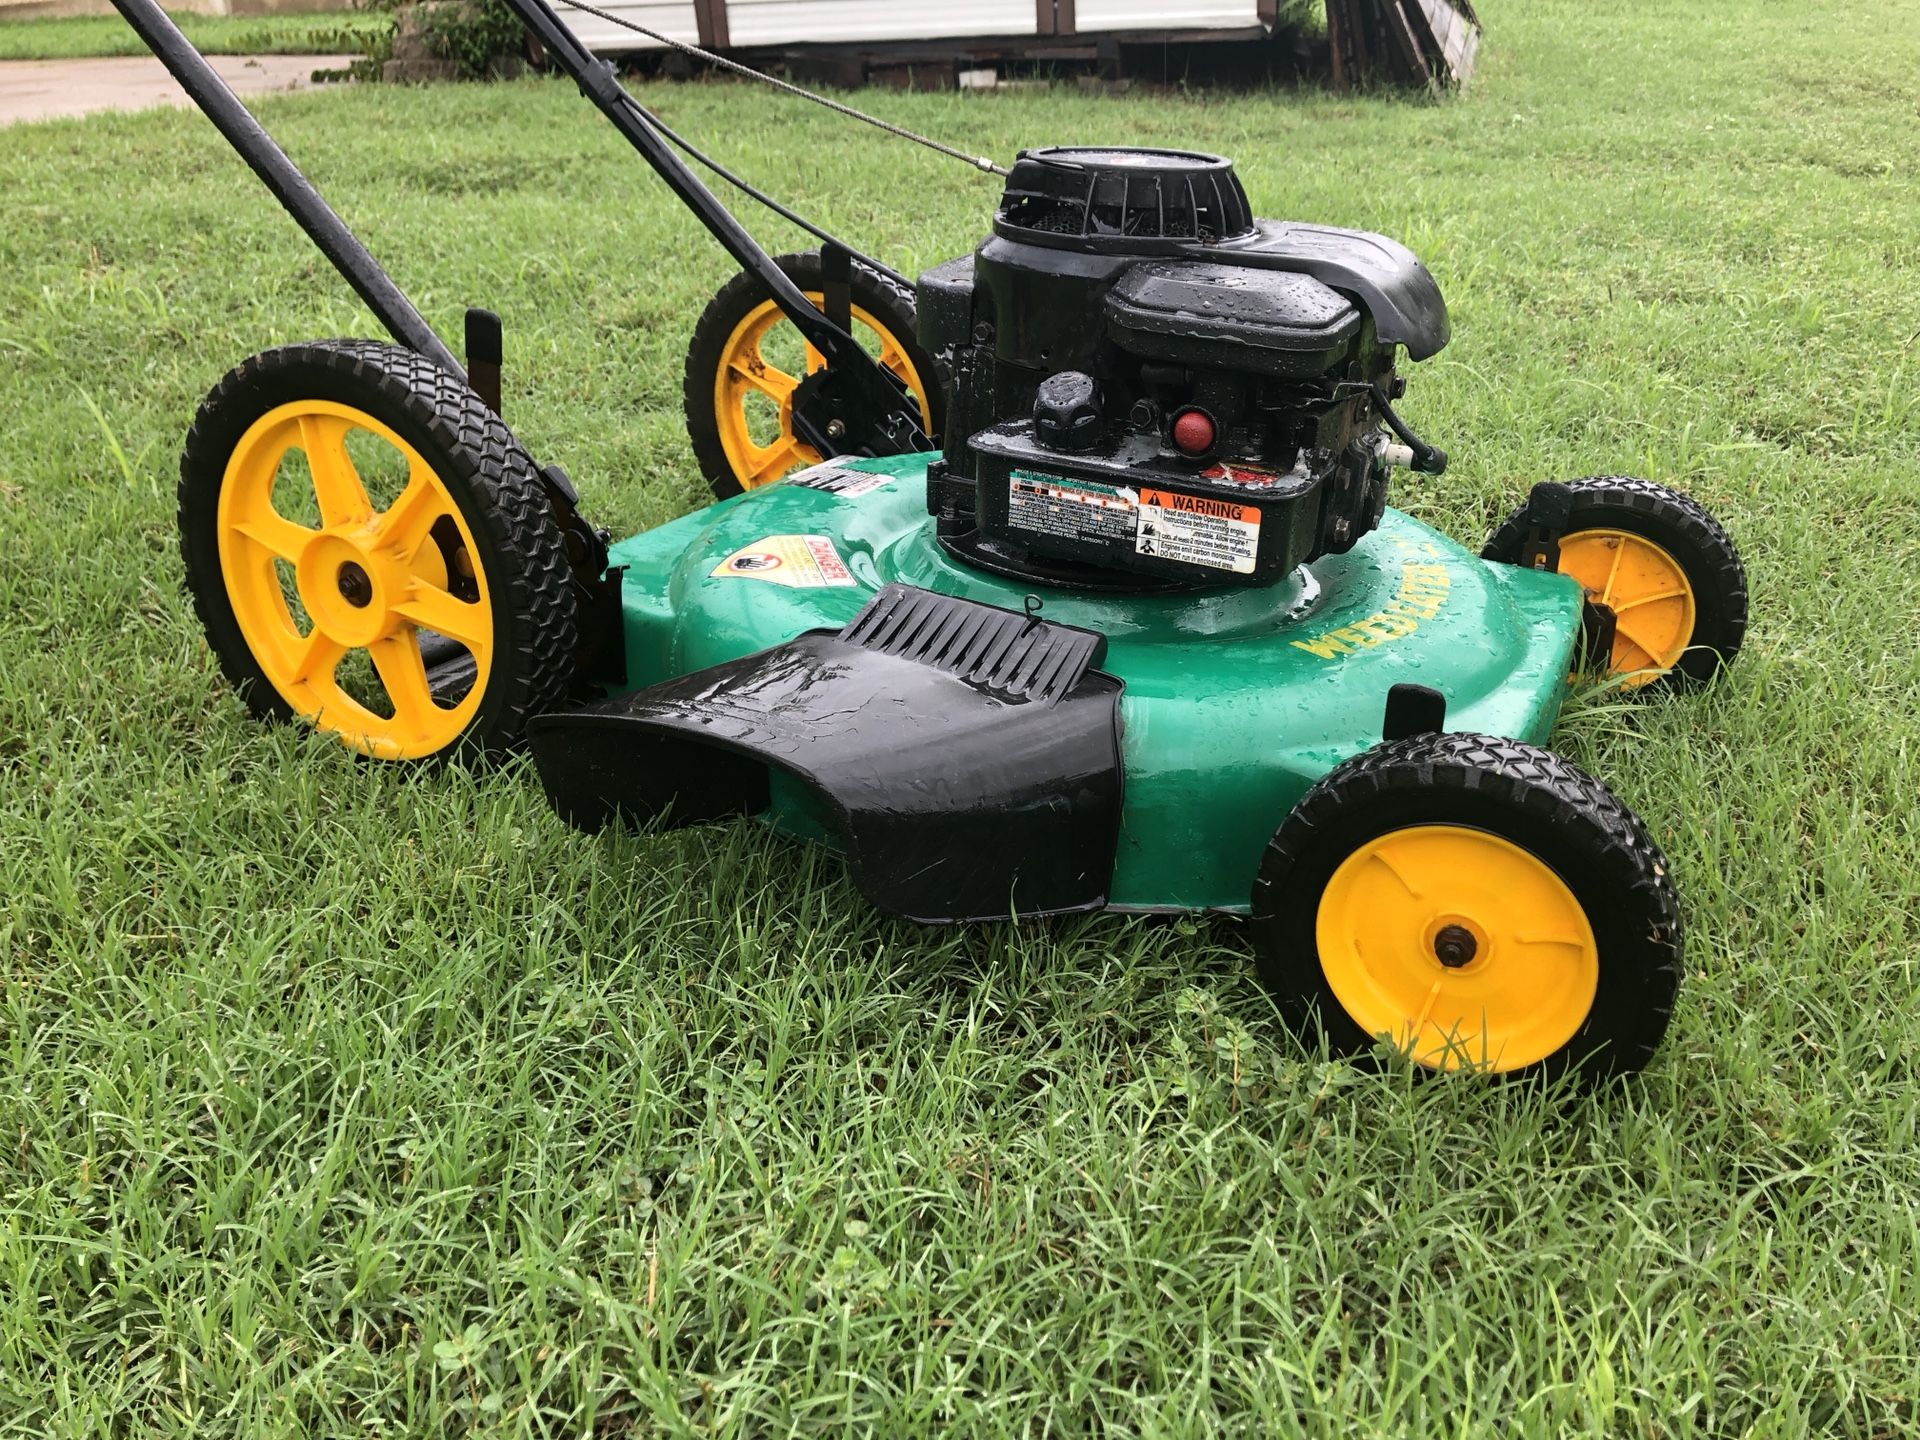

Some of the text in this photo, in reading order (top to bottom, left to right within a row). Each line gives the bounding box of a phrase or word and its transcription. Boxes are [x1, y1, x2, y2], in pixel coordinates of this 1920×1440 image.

[1172, 495, 1242, 520] WARNING
[1163, 515, 1247, 538] Instructions before running engine.
[1187, 512, 1202, 521] follow
[1203, 516, 1228, 528] Operating
[1194, 538, 1213, 548] minutes
[1214, 542, 1228, 550] before
[1215, 534, 1228, 542] Allow
[1229, 537, 1245, 547] engine
[1160, 542, 1180, 552] Engines
[1193, 548, 1210, 556] carbon
[808, 540, 848, 579] DANGER
[1197, 557, 1220, 567] enclosed
[1289, 612, 1418, 660] WEED
